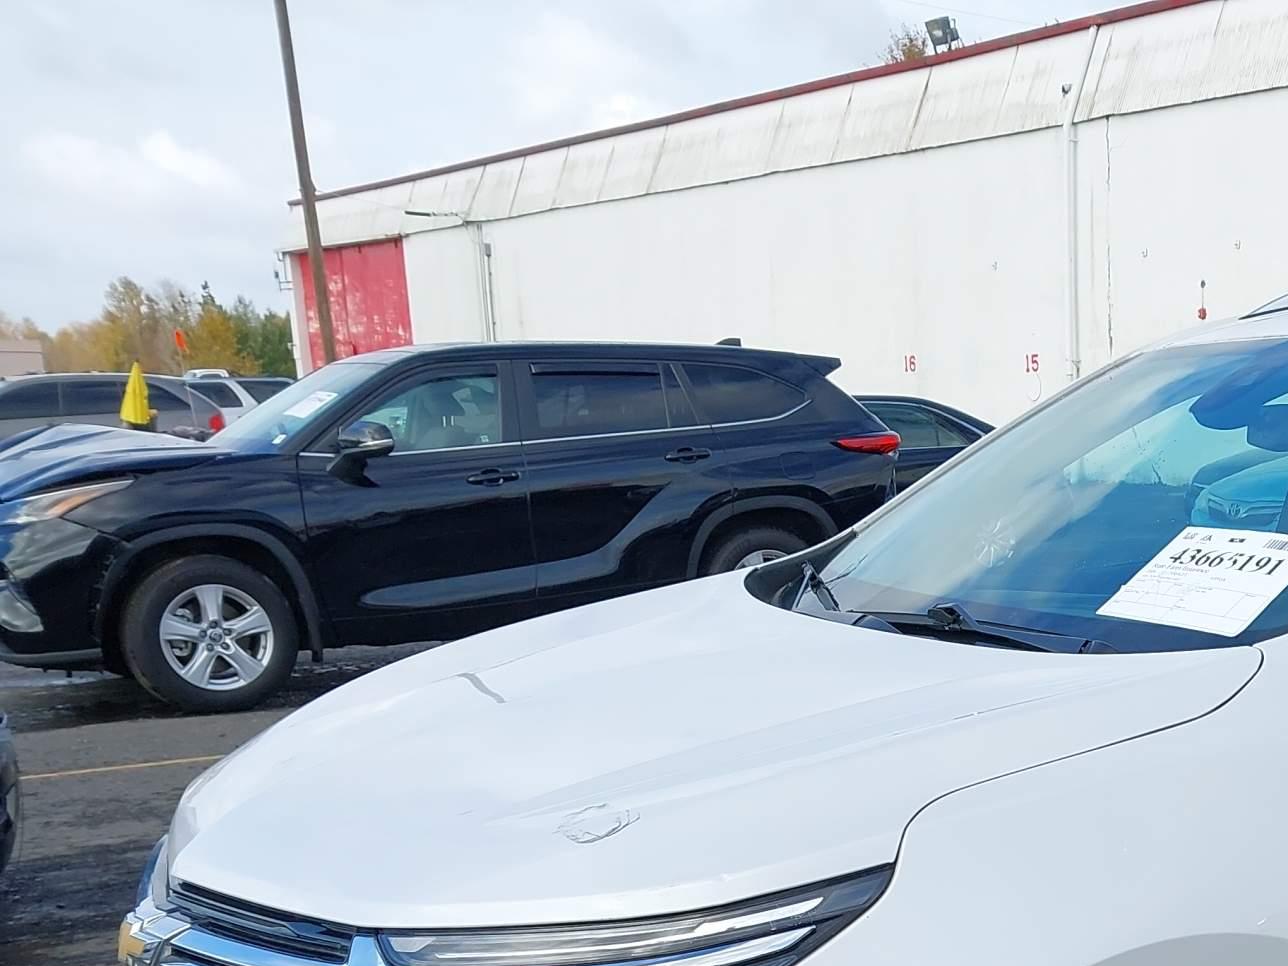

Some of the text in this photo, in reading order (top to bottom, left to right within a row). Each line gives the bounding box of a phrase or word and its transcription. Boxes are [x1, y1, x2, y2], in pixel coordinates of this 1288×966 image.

[904, 355, 917, 372] 16
[1025, 354, 1039, 373] 15
[1169, 547, 1286, 575] 43665191
